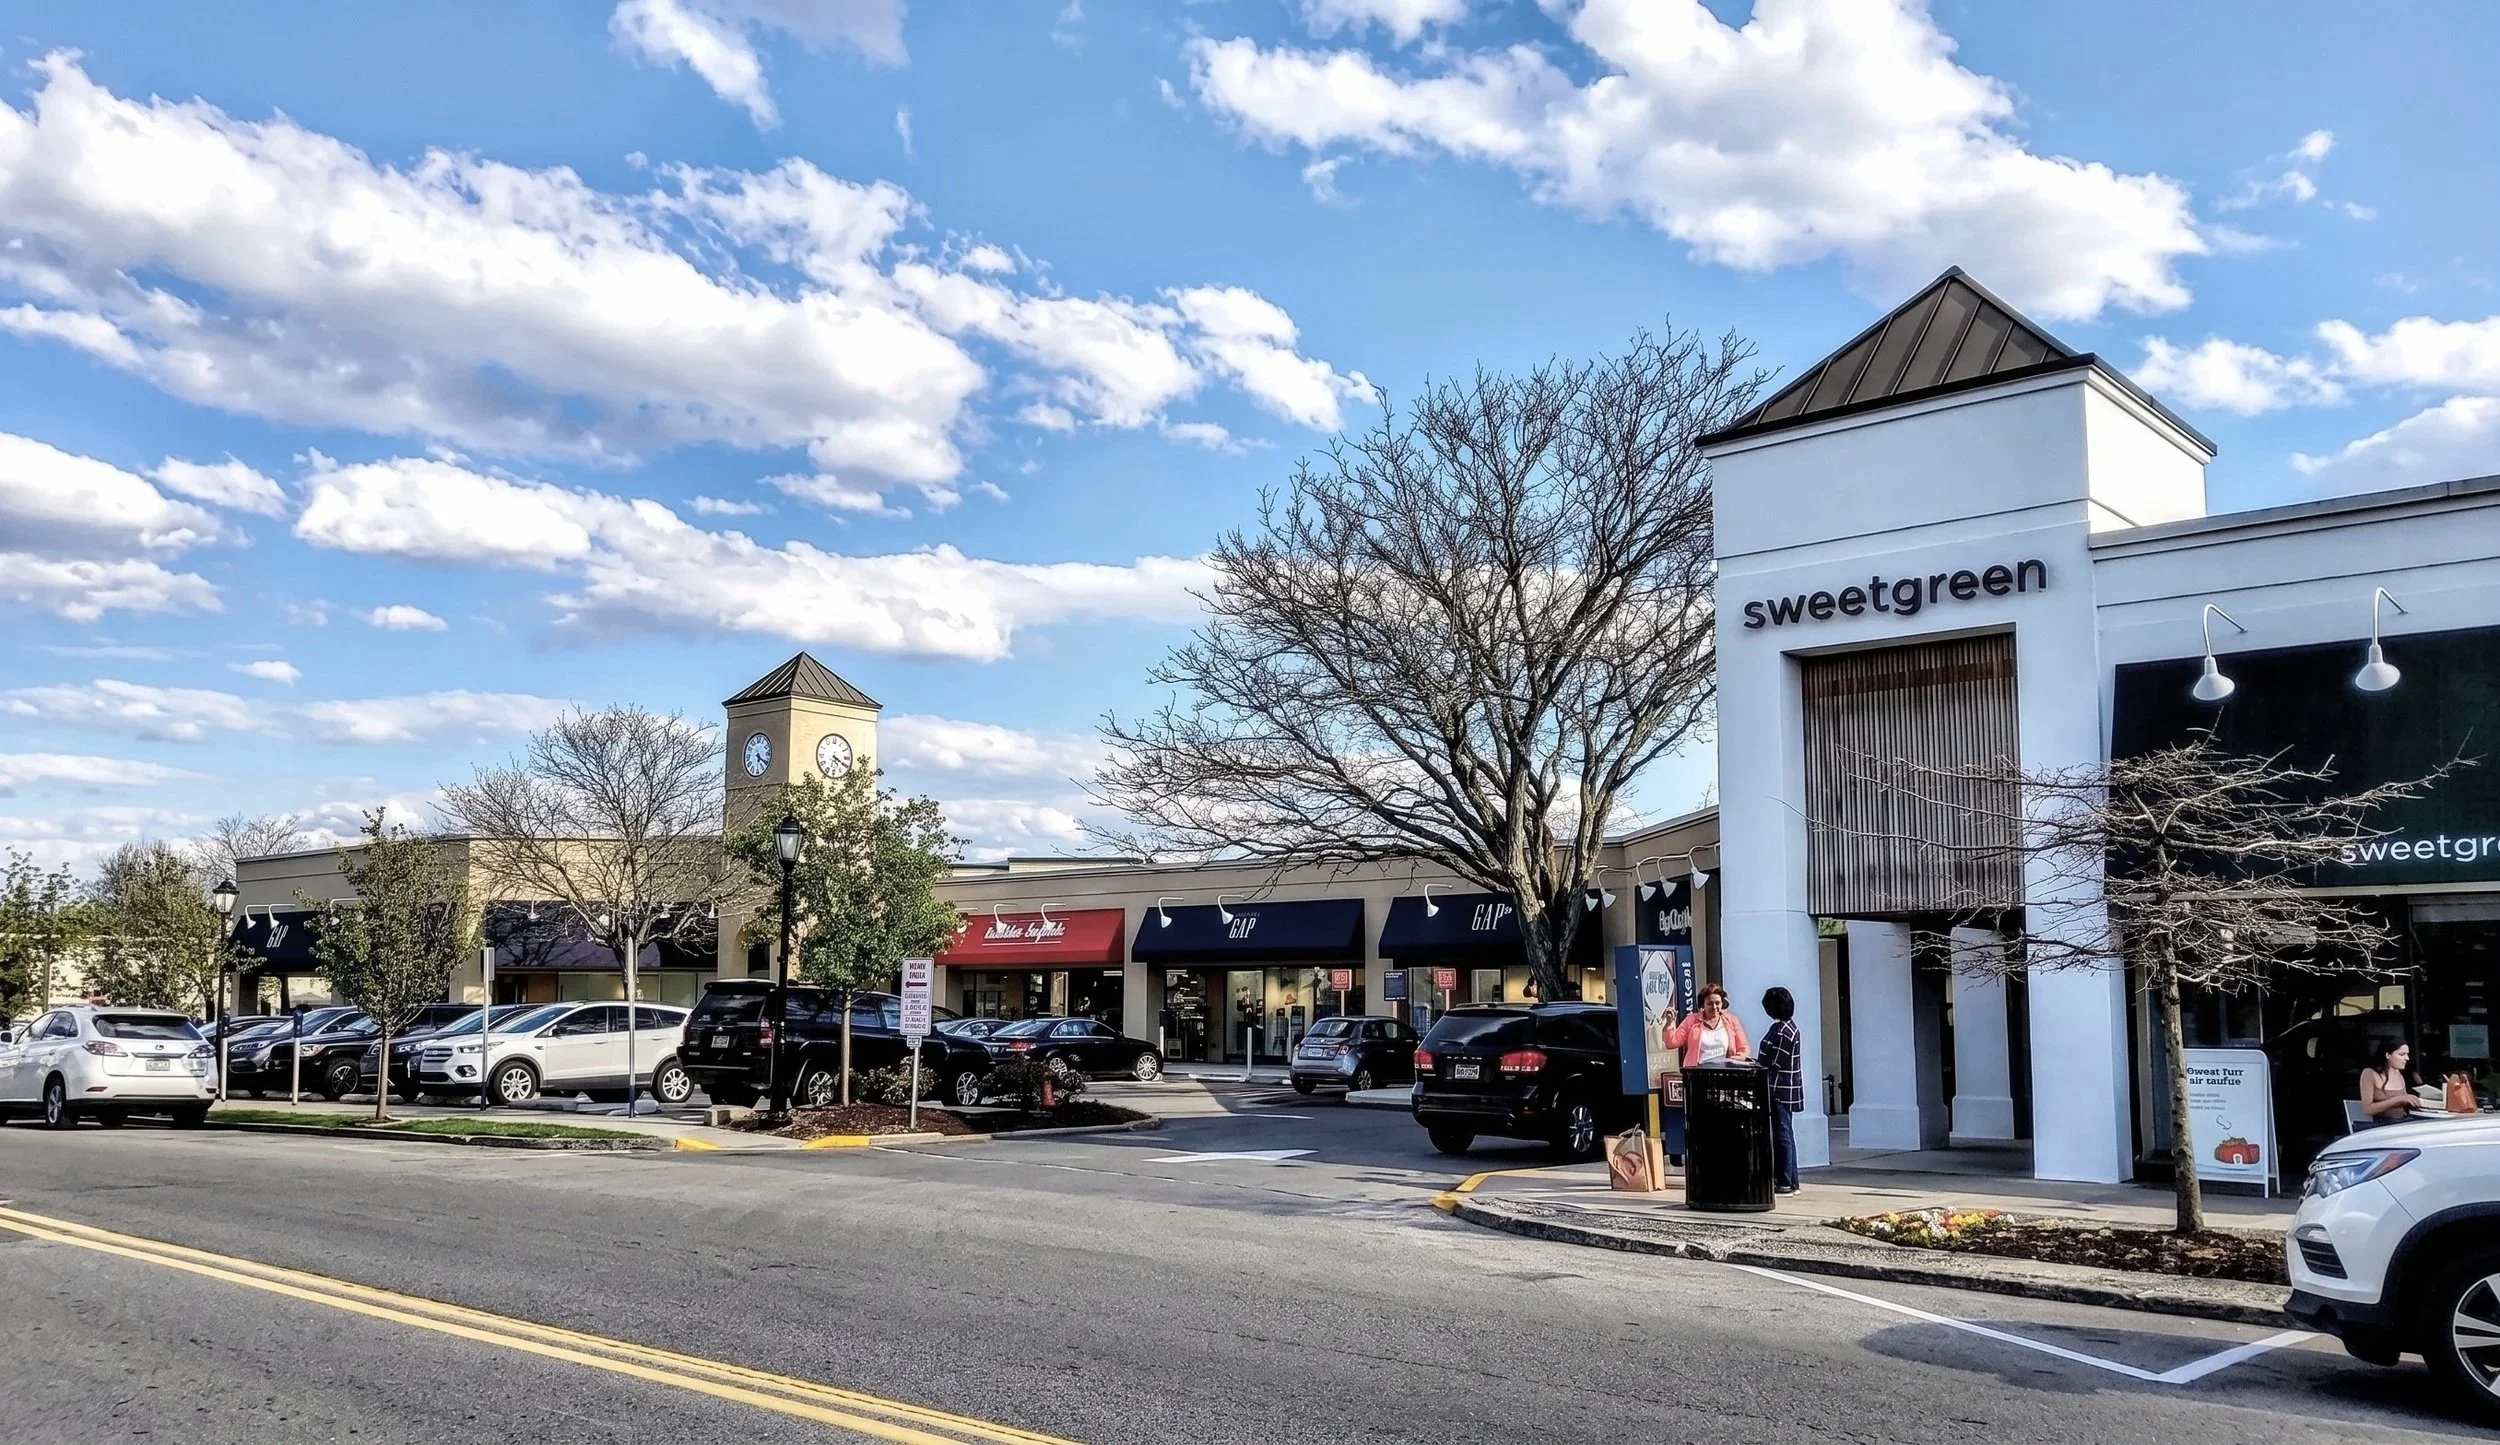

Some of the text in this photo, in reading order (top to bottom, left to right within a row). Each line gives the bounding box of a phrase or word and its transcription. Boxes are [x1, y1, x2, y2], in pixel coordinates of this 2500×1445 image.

[1743, 557, 2047, 630] sweetgreen
[2340, 834, 2500, 862] sweetgr
[1229, 917, 1257, 939] GAP
[1471, 903, 1506, 931] GAP
